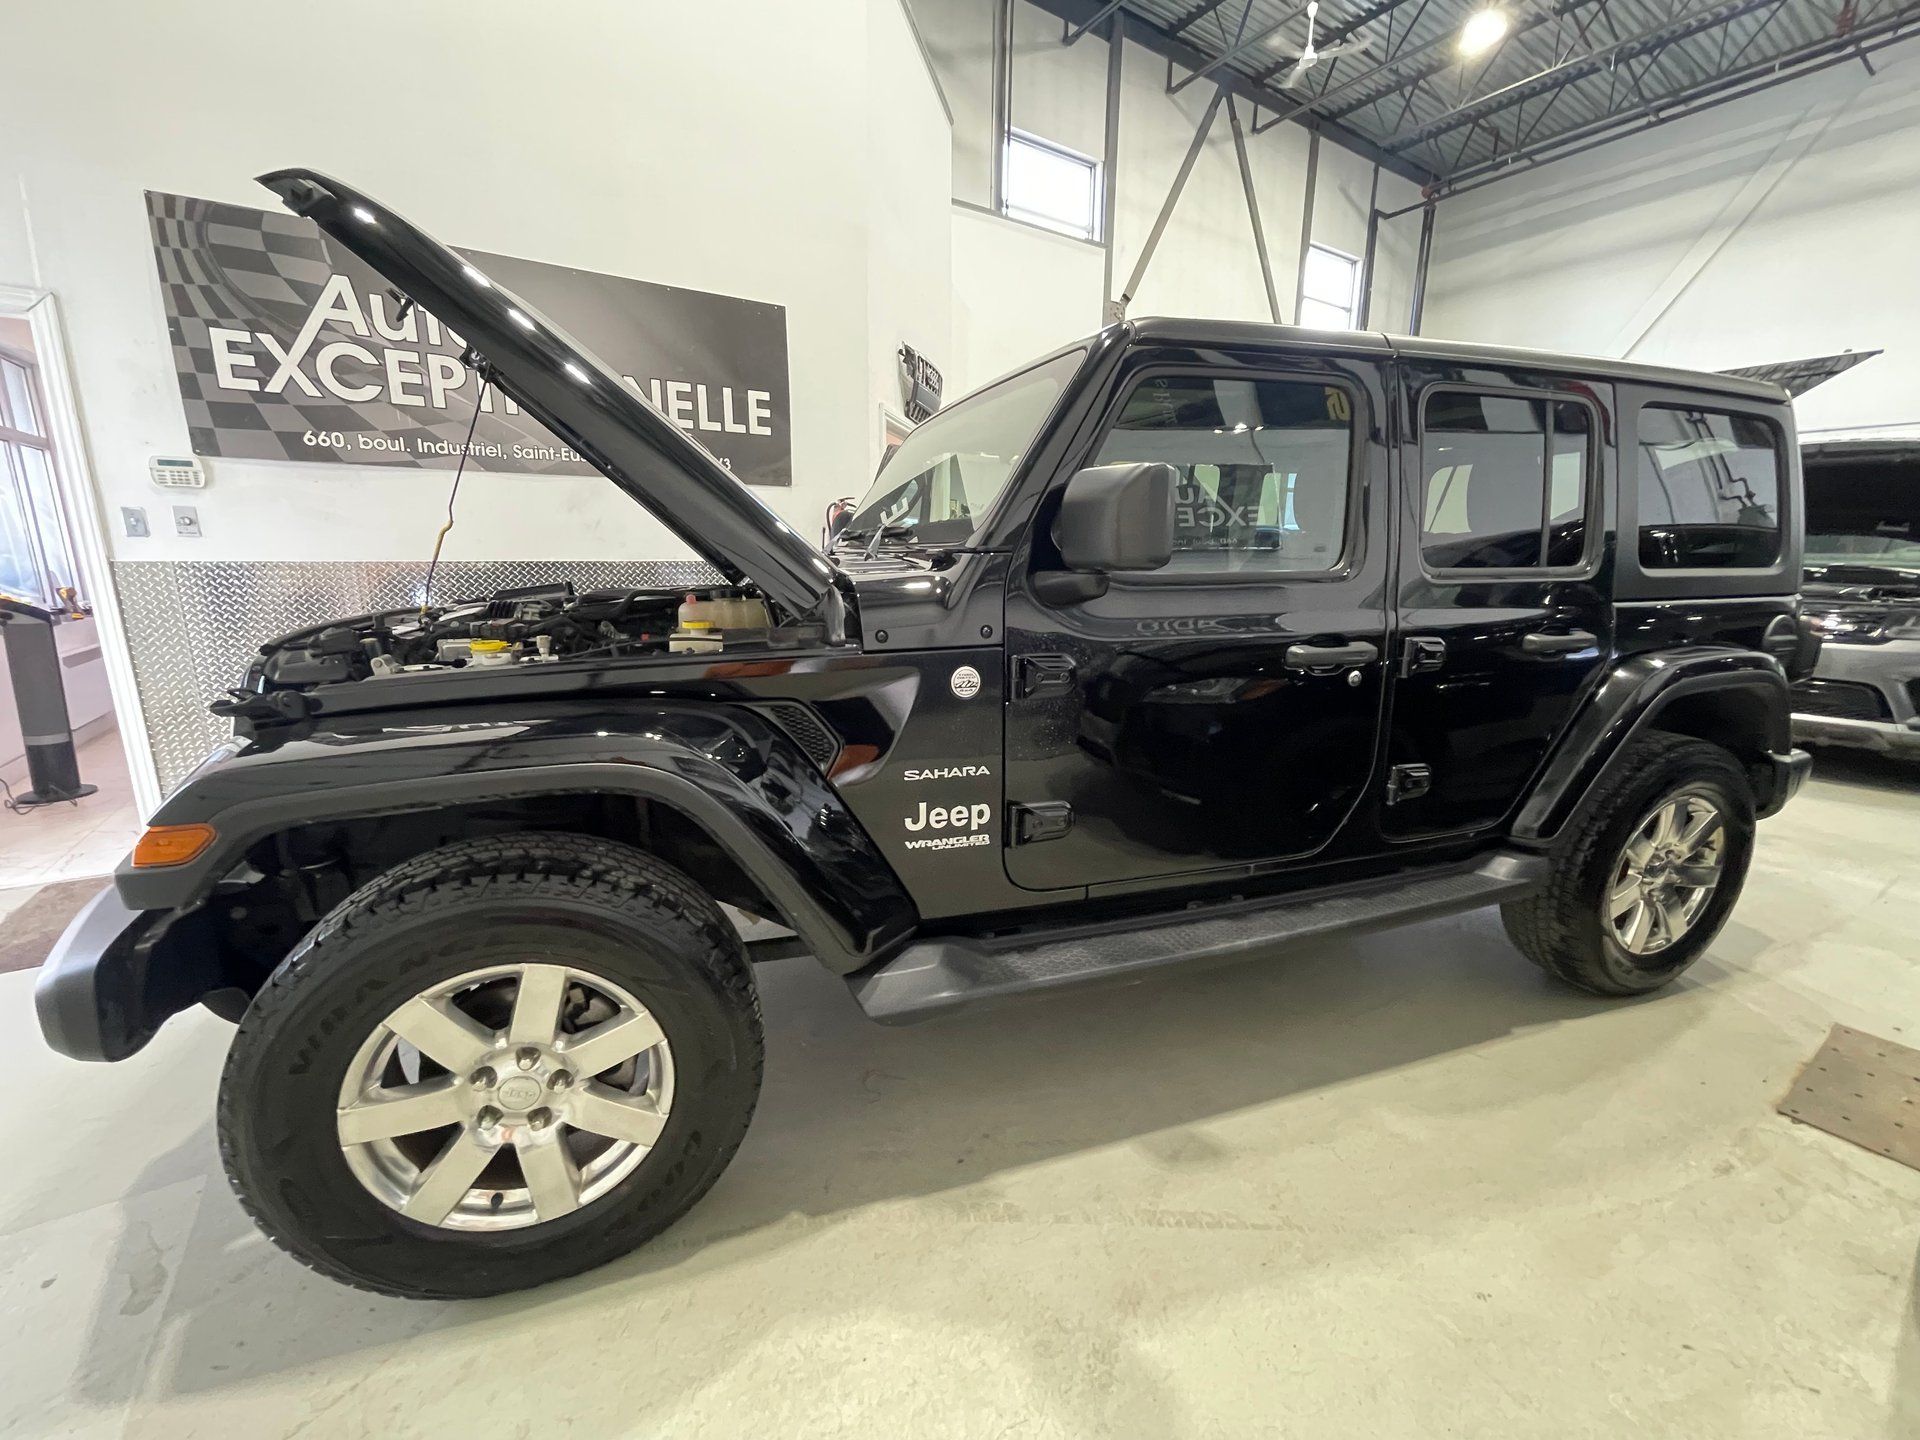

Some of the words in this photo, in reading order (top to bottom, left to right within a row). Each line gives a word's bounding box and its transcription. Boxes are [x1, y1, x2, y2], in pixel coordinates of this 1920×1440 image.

[300, 273, 468, 349] Aut
[303, 430, 352, 451] 660,
[358, 433, 411, 453] boul.
[417, 438, 507, 460] Industriel,
[512, 444, 587, 462] Saint-Eu
[904, 765, 991, 781] SAHARA
[904, 802, 991, 832] Jeep
[904, 834, 991, 850] WRANGLER
